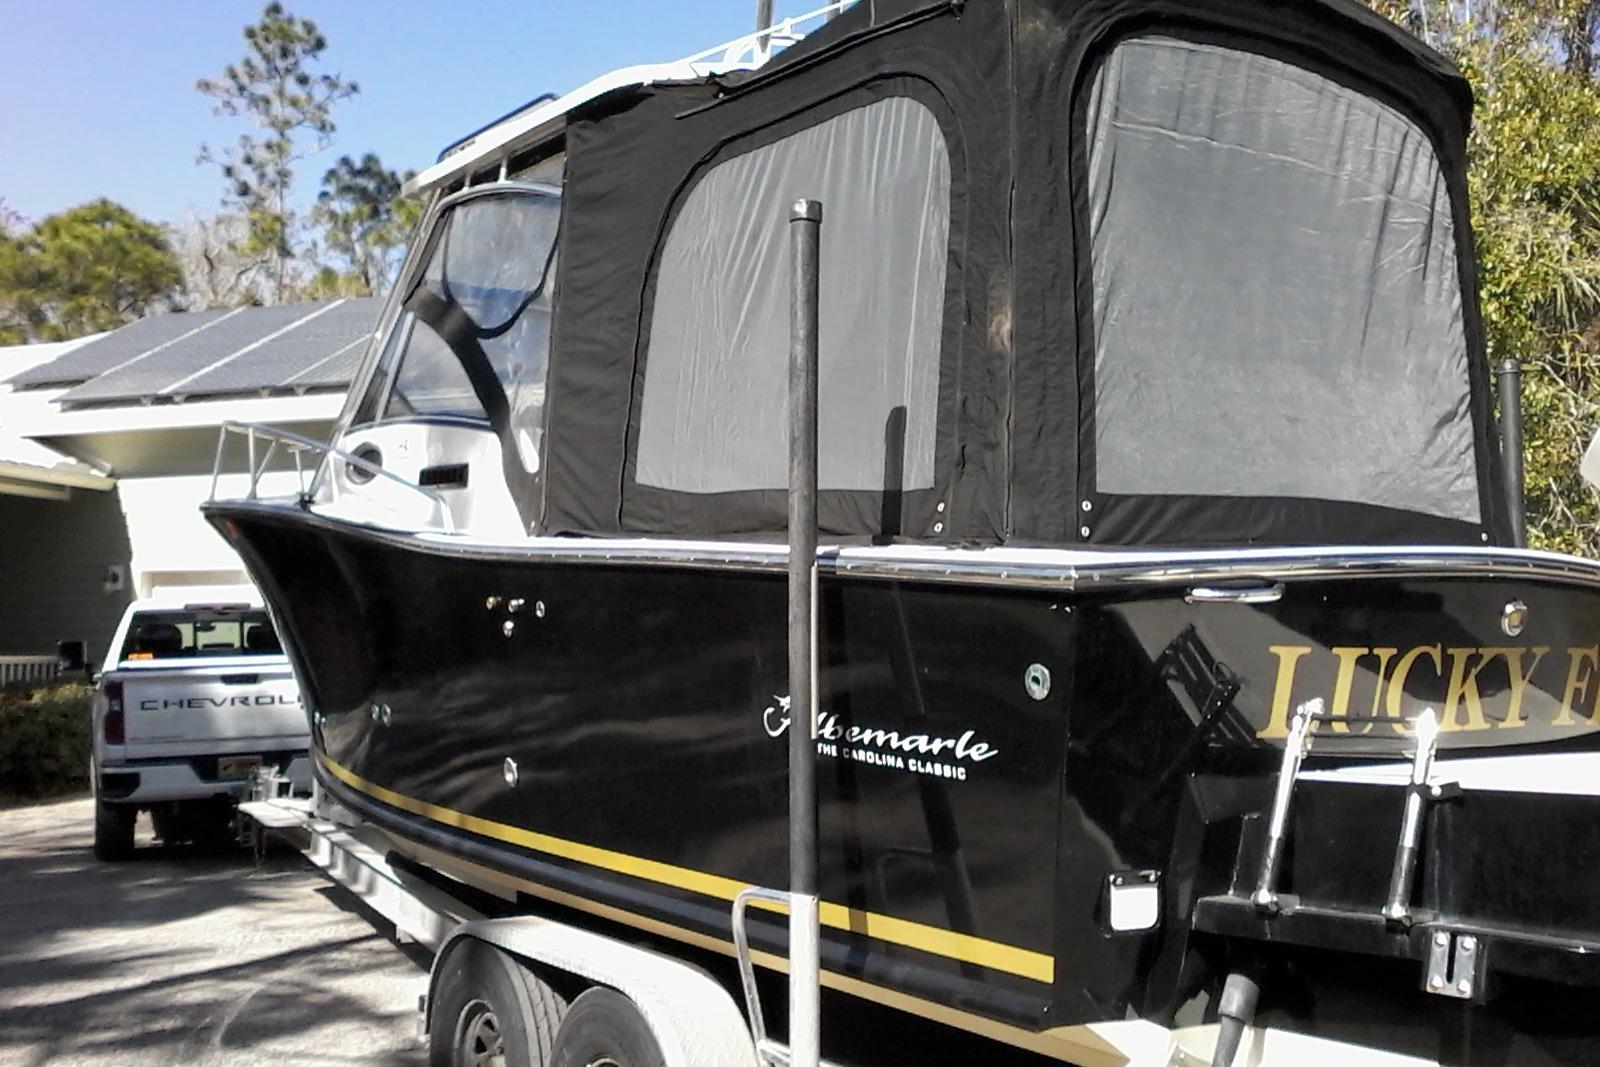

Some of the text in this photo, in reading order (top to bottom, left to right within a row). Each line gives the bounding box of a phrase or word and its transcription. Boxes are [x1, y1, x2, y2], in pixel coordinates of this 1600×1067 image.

[140, 695, 304, 711] CHEVROL
[1255, 643, 1600, 739] LUCKY F
[817, 742, 967, 781] THE CAROLINA CLASSIC
